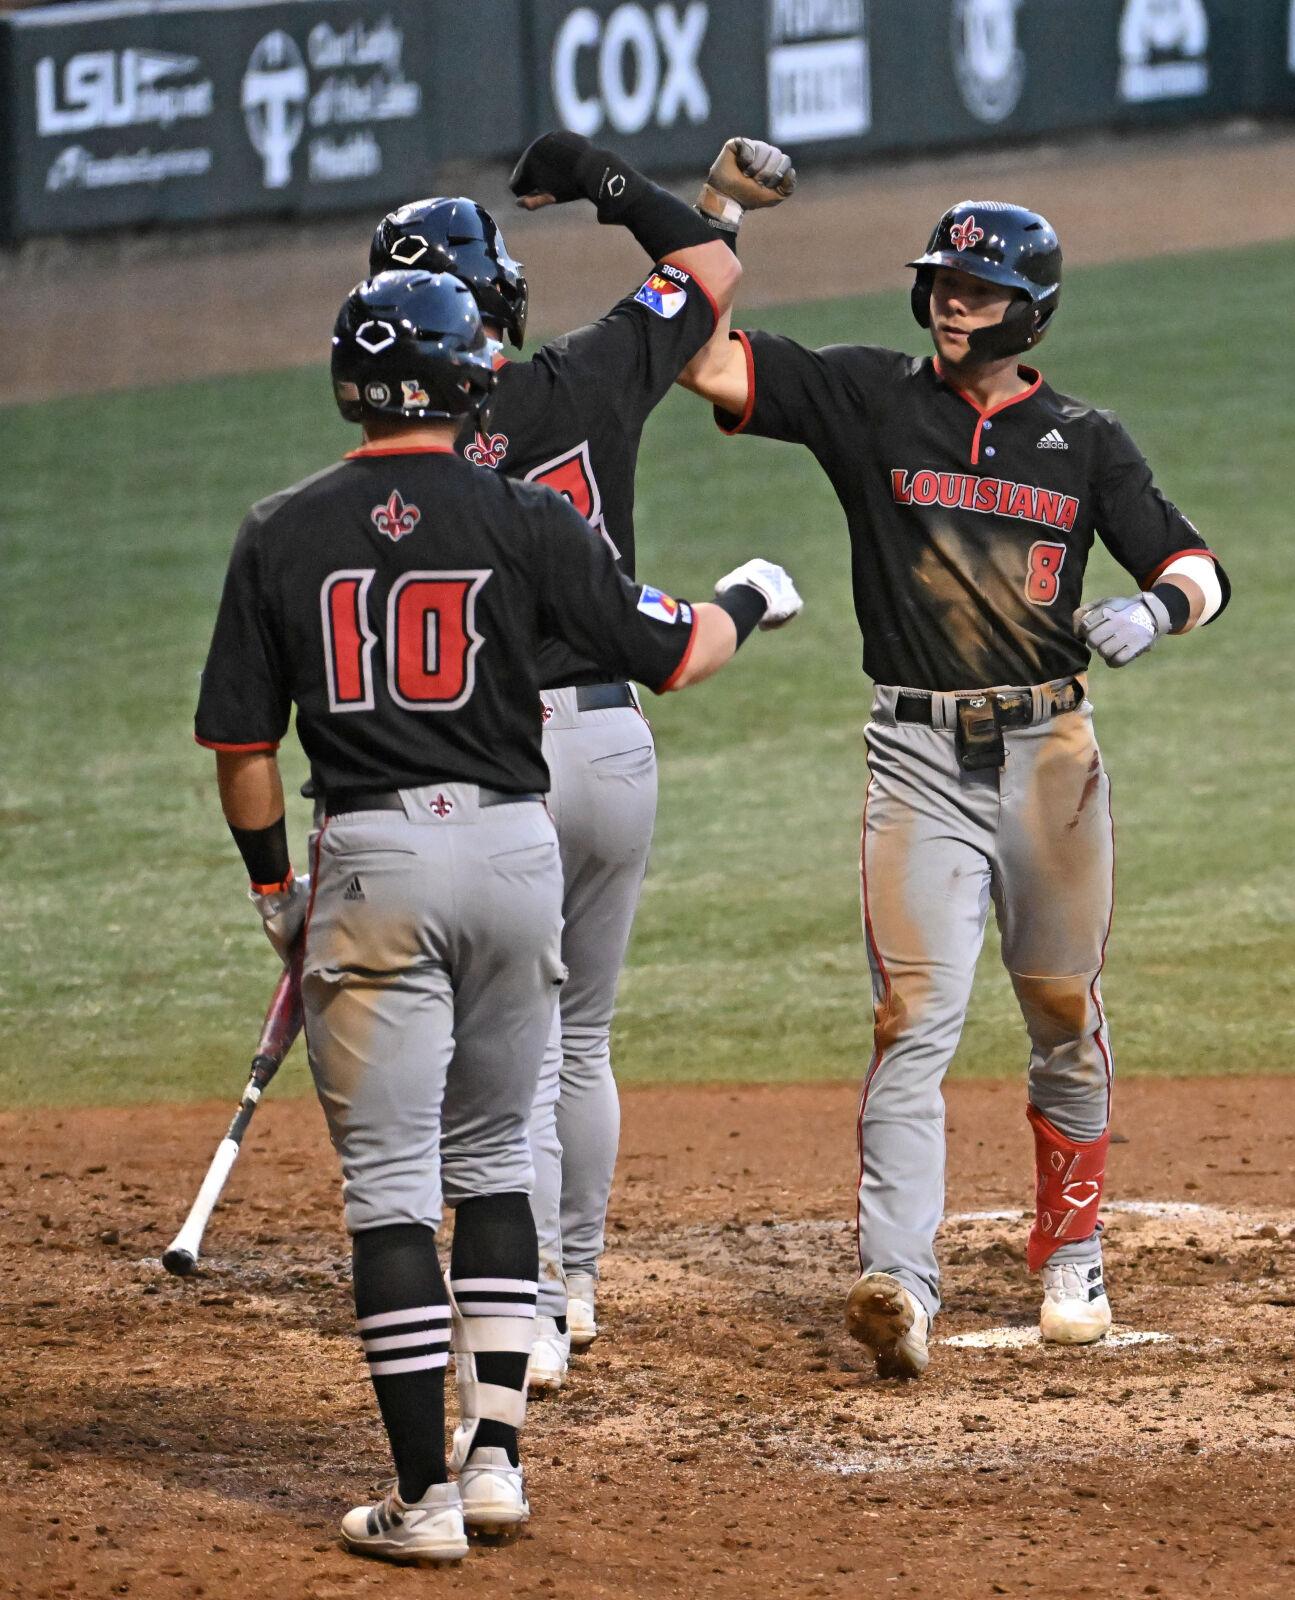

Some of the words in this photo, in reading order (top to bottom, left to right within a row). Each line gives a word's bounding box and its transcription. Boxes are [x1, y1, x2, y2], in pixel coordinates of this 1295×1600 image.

[36, 49, 137, 136] LSU
[554, 3, 710, 137] COX
[661, 264, 690, 284] ROBE
[1036, 441, 1069, 450] adidas
[891, 469, 1079, 532] LOUISIANA
[1025, 540, 1066, 606] 8
[320, 568, 494, 713] 10
